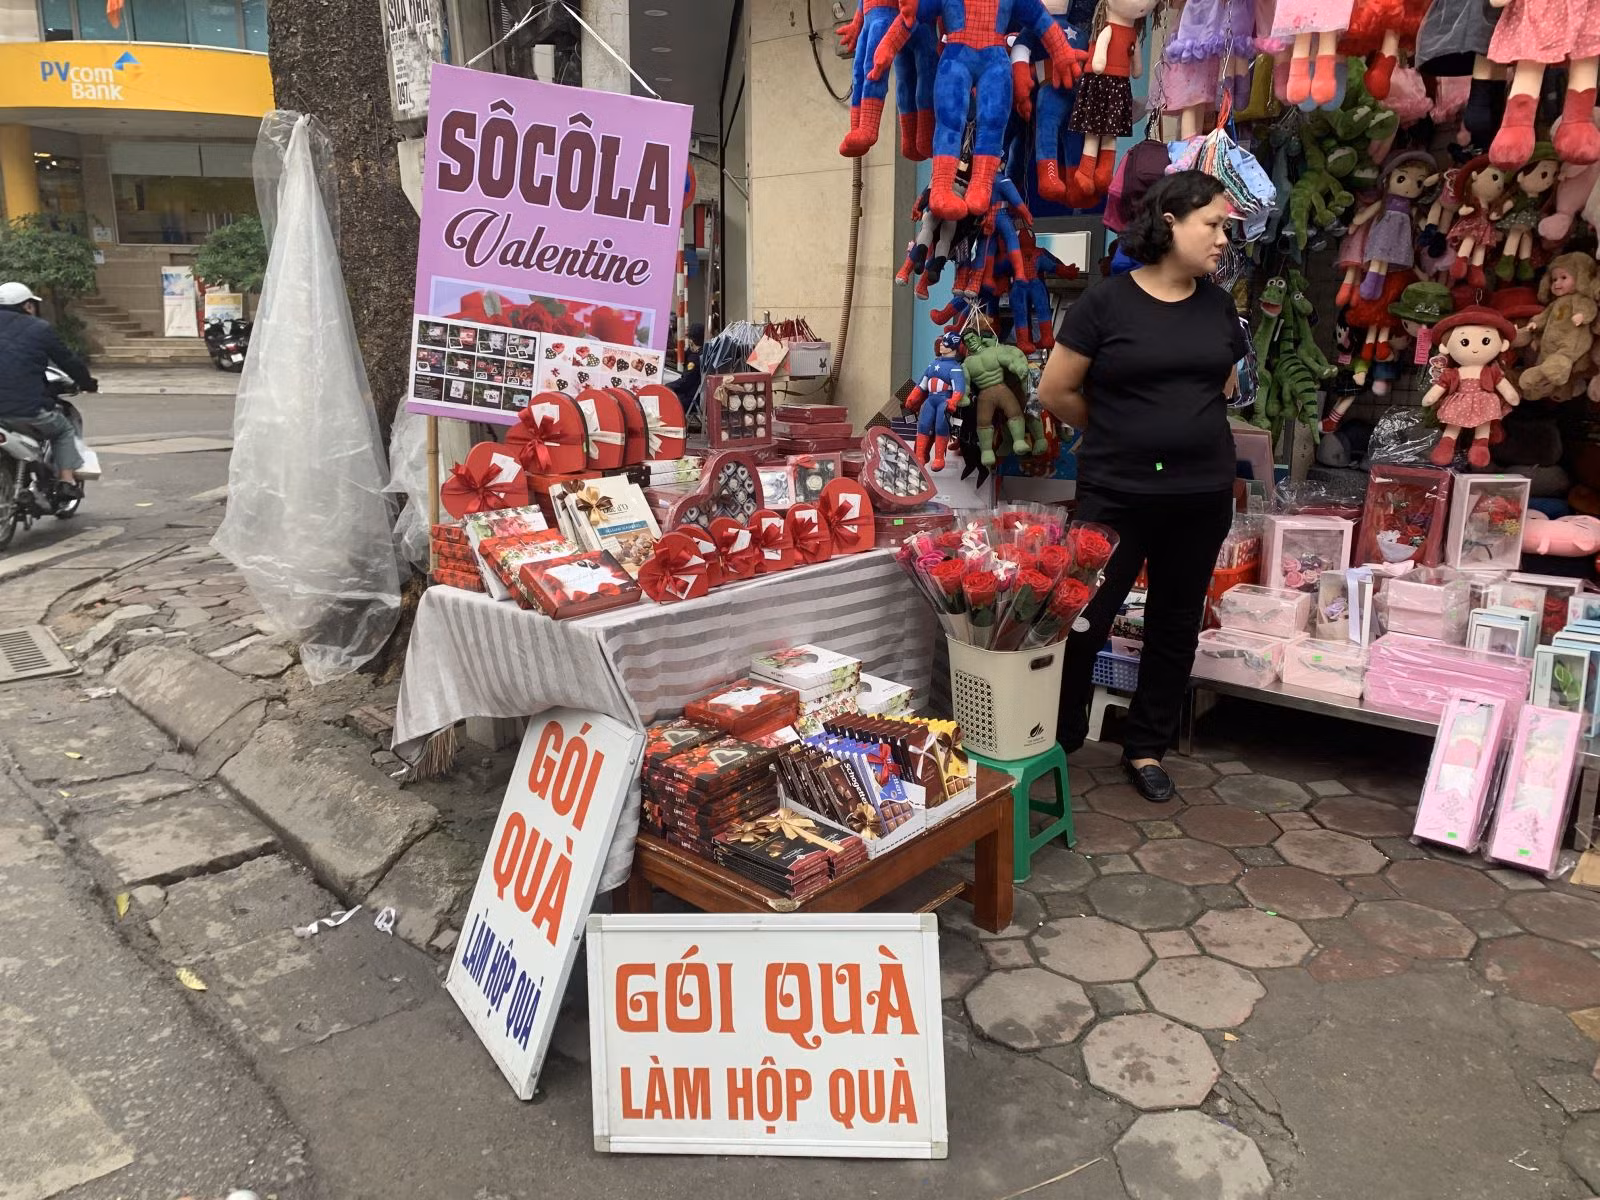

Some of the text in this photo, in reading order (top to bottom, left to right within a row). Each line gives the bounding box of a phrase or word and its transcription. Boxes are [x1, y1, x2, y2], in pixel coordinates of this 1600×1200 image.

[71, 82, 124, 100] Bank
[438, 100, 671, 226] SÔCÔLA
[444, 208, 651, 286] Valentine
[528, 721, 605, 831] GÓI
[494, 812, 573, 945] QUÀ
[462, 908, 544, 1051] LÀM HỘP QUÀ
[616, 945, 919, 1051] GÓI QUÀ
[621, 1056, 917, 1134] LÀM HỘP QUÀ
